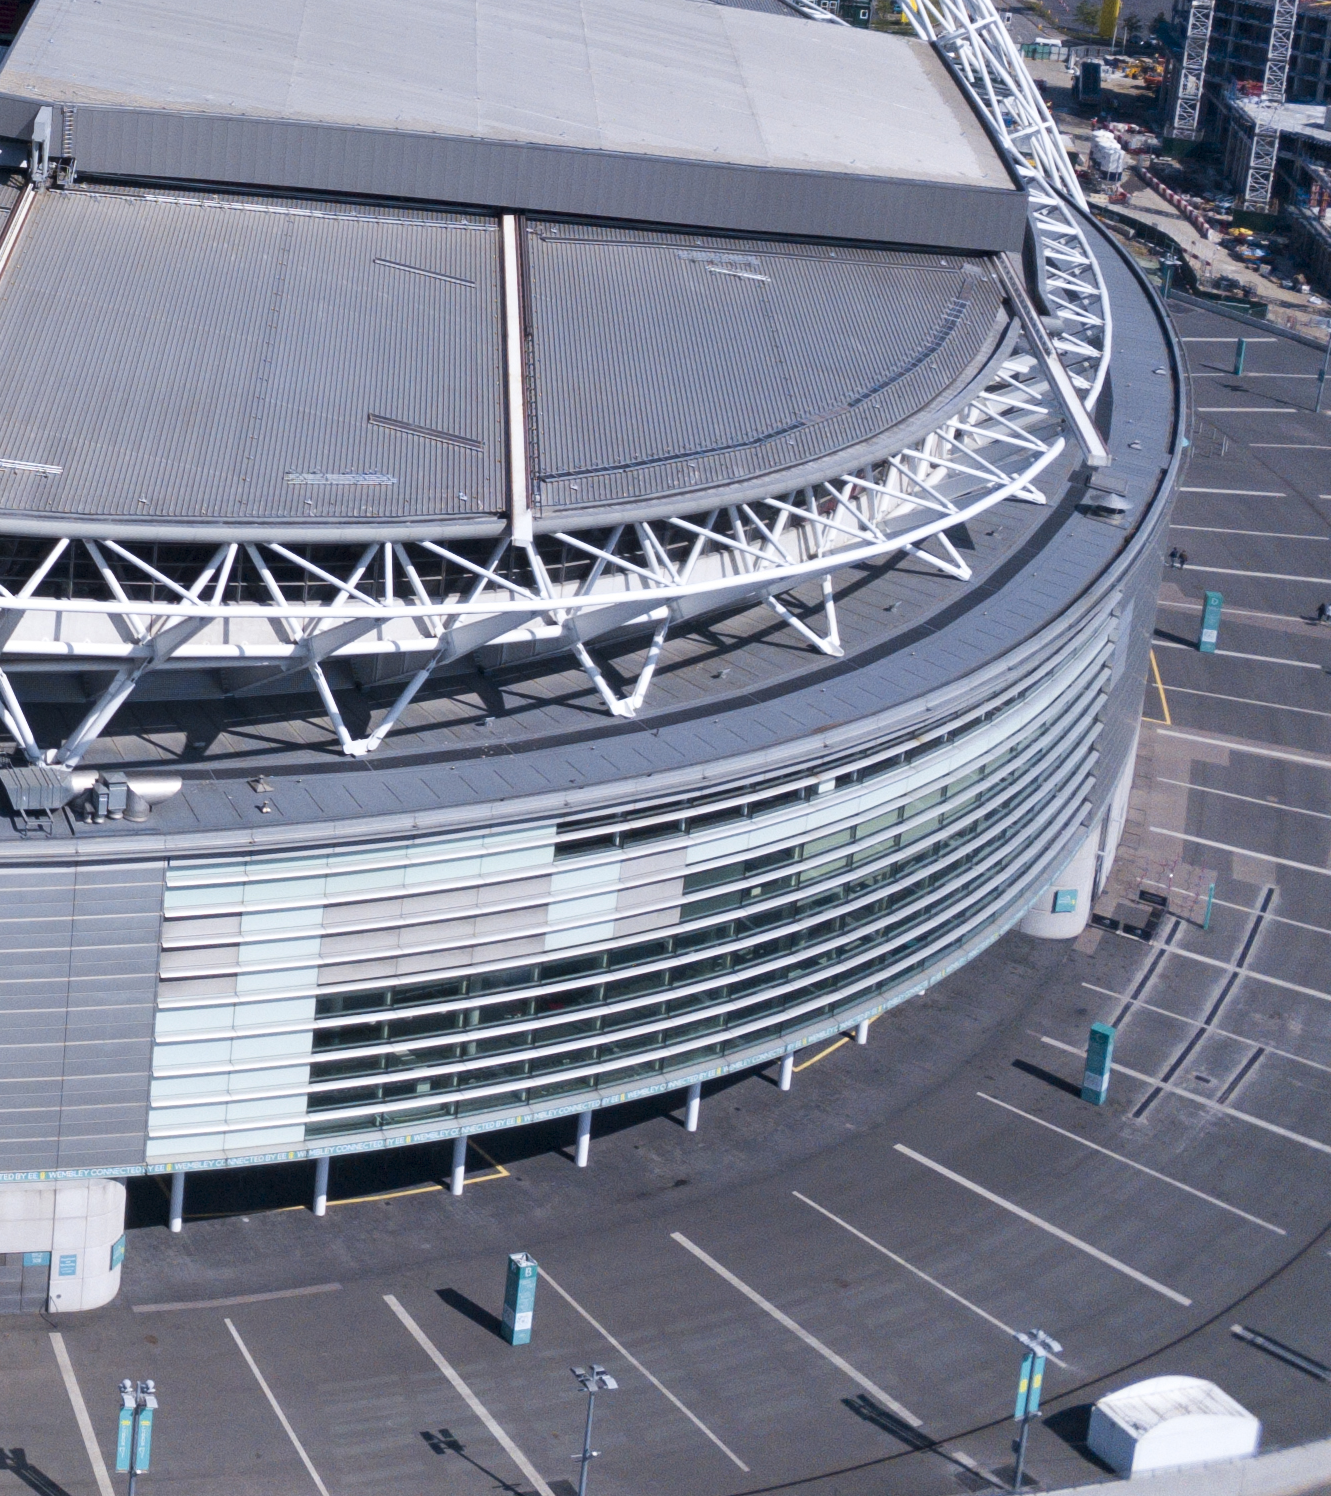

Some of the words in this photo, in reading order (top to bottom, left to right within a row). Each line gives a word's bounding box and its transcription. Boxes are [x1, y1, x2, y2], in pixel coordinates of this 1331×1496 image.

[524, 1106, 559, 1123] WMBLEY
[559, 1098, 601, 1116] CONNECTED
[611, 1094, 619, 1104] EE
[413, 1127, 450, 1142] WEMBLEY
[495, 1118, 506, 1129] BY
[506, 1117, 515, 1128] EE
[297, 1145, 335, 1158] WMBLEY
[335, 1138, 384, 1153] CONNECTED
[395, 1135, 405, 1146] EE
[48, 1168, 90, 1179] WEMBLEY
[90, 1165, 142, 1177] CONNECTED
[142, 1164, 154, 1173] Y
[154, 1163, 165, 1173] EE
[174, 1158, 215, 1171] WEMBLEY
[265, 1153, 277, 1163] BY
[276, 1152, 287, 1162] EE
[15, 1172, 28, 1181] BY
[28, 1171, 38, 1181] EE
[525, 1267, 532, 1277] B
